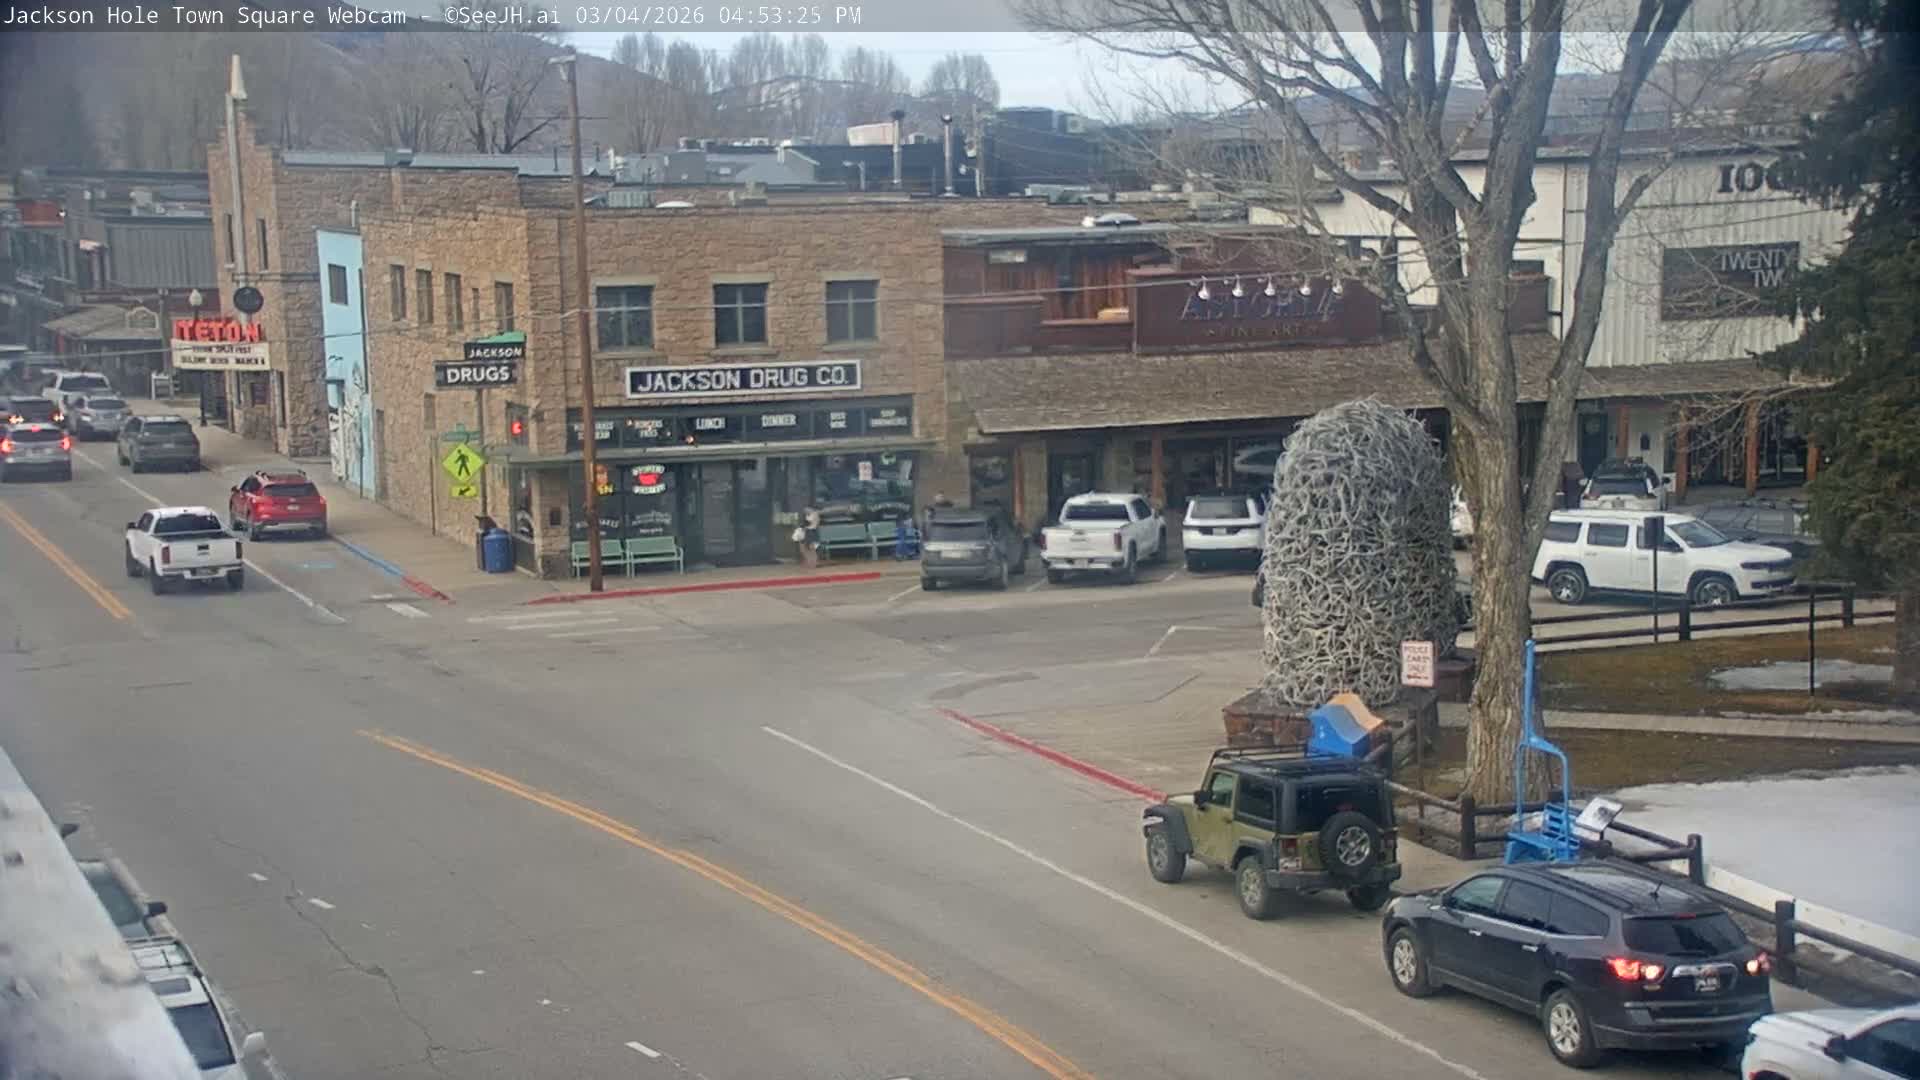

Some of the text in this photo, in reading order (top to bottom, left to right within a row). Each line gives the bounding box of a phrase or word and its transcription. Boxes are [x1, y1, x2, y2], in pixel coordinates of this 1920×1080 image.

[1720, 249, 1795, 271] TWENTY
[176, 319, 262, 343] TETON
[468, 347, 523, 359] JACKSON
[446, 365, 510, 384] DRUGS
[637, 365, 850, 392] JACKSON DRUG CO.
[695, 417, 726, 430] LUNCH
[761, 413, 797, 428] DINNER
